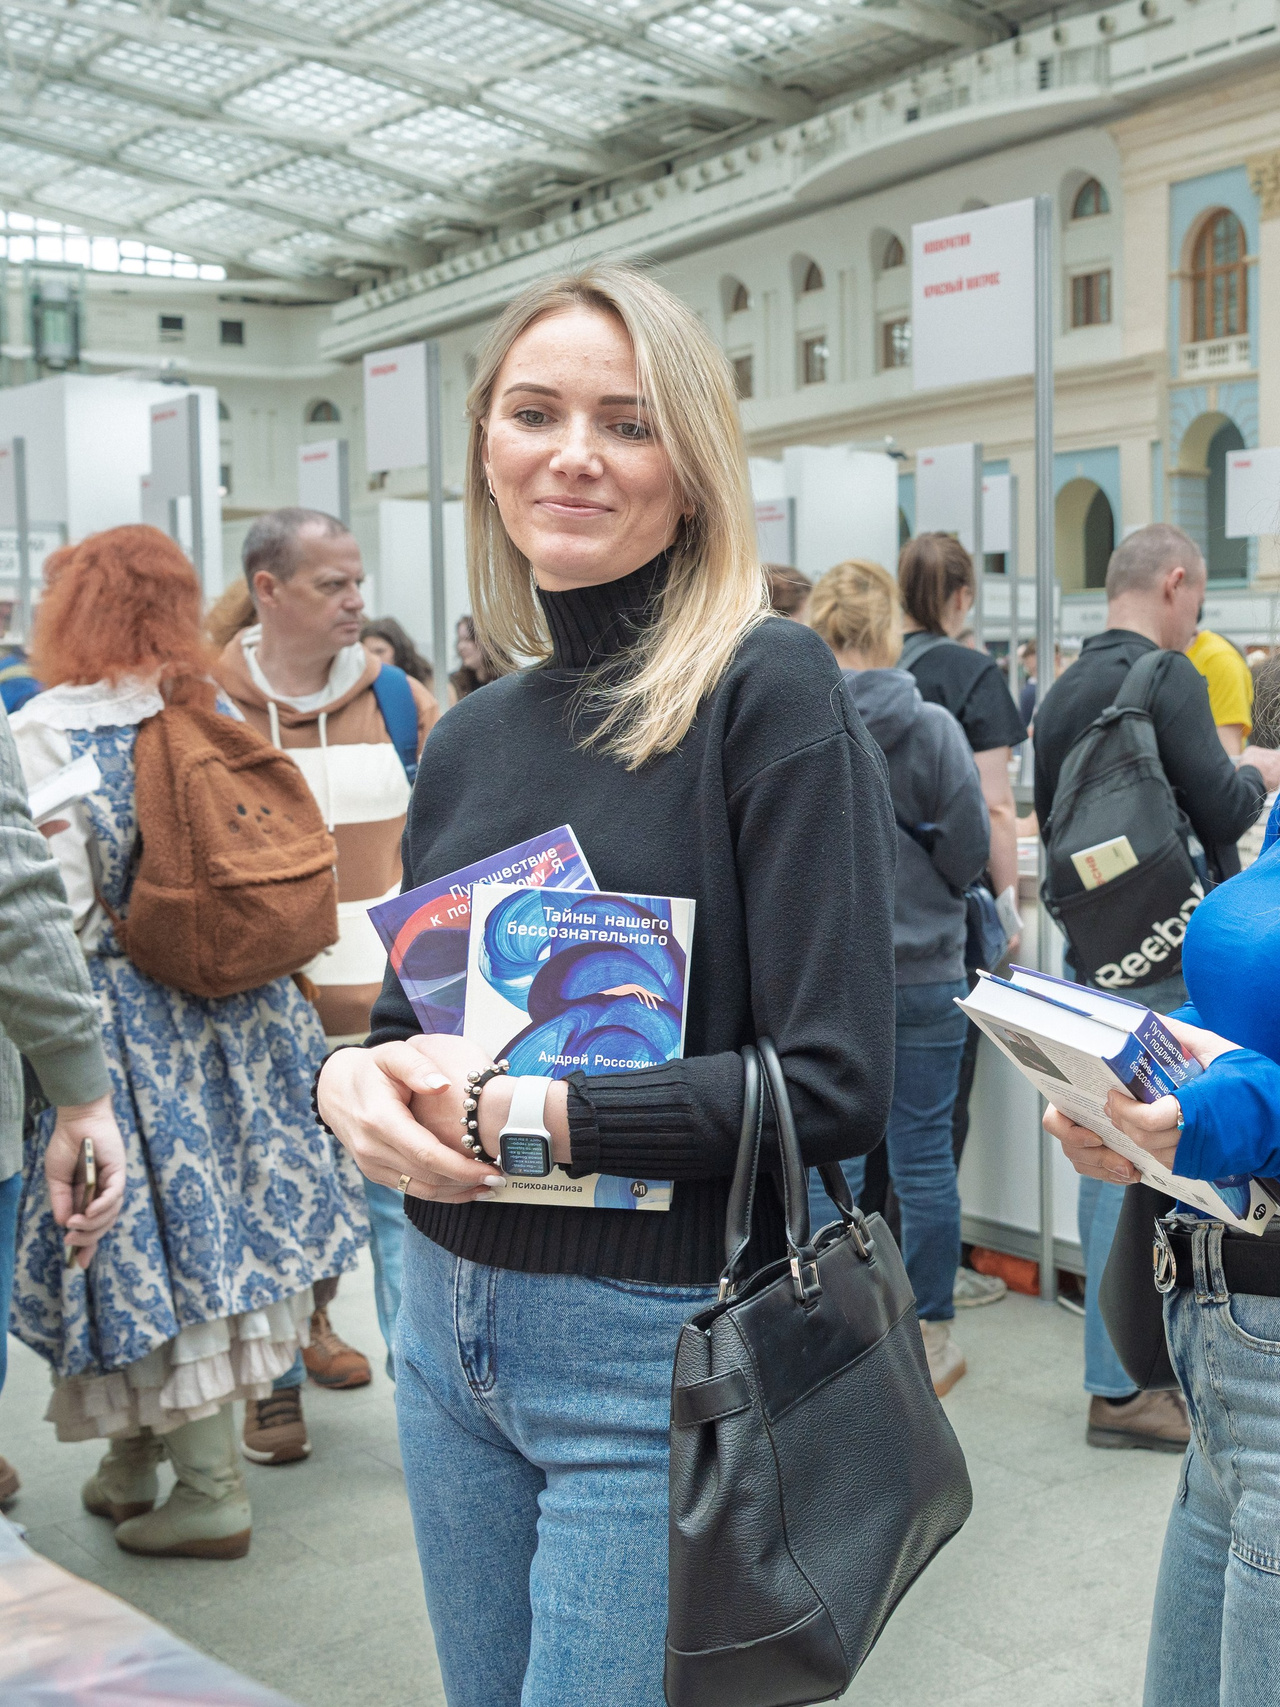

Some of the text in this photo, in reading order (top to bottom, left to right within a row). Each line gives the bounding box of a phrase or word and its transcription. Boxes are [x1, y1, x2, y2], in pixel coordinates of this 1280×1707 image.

[551, 858, 565, 874] Я
[543, 906, 669, 931] Тайны нашего
[507, 920, 668, 946] бессознательного
[1095, 876, 1205, 989] Reebo
[1149, 1020, 1191, 1069] Путешествие
[538, 1050, 589, 1067] Андрей
[1136, 1049, 1154, 1076] Тайны
[1149, 1038, 1188, 1081] подлинному
[1129, 1060, 1162, 1100] бессознате
[512, 1181, 583, 1193] психоанализа
